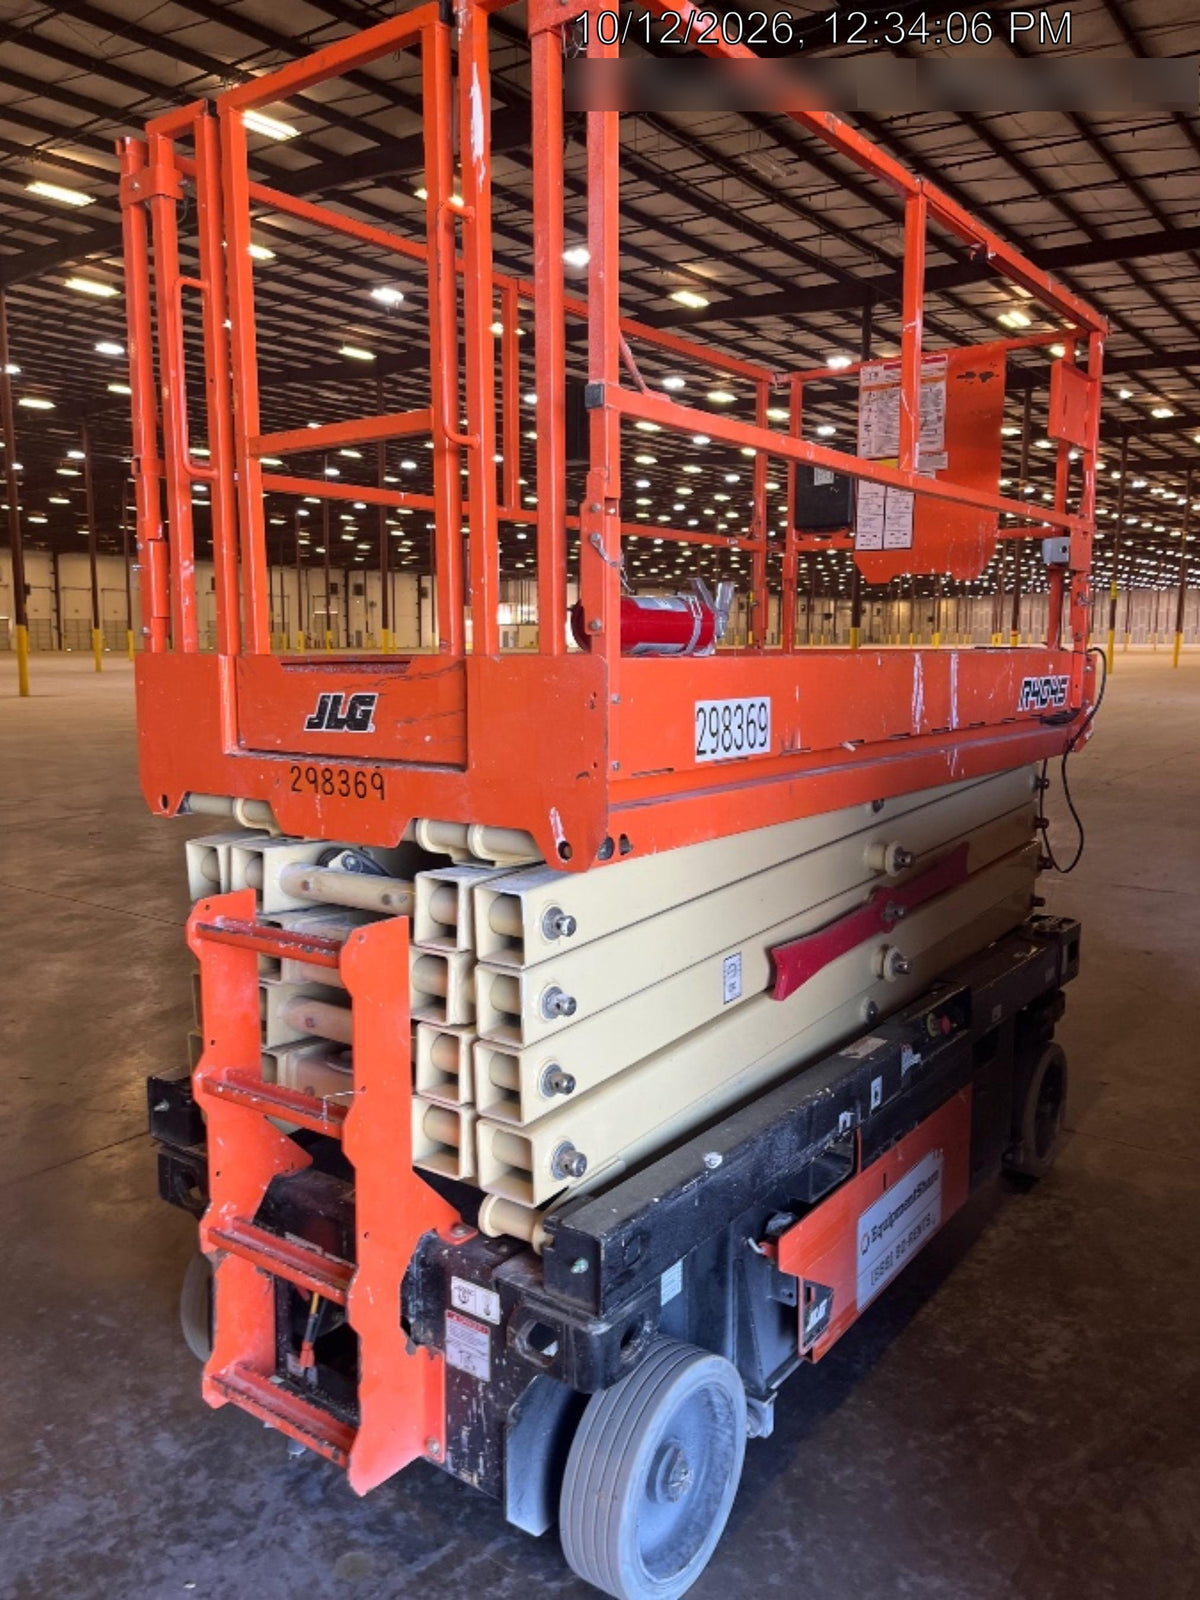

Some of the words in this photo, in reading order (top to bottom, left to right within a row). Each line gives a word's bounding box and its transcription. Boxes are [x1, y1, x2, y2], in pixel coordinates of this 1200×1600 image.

[304, 692, 379, 733] JLG
[696, 702, 768, 756] 298369
[290, 765, 385, 801] 298369
